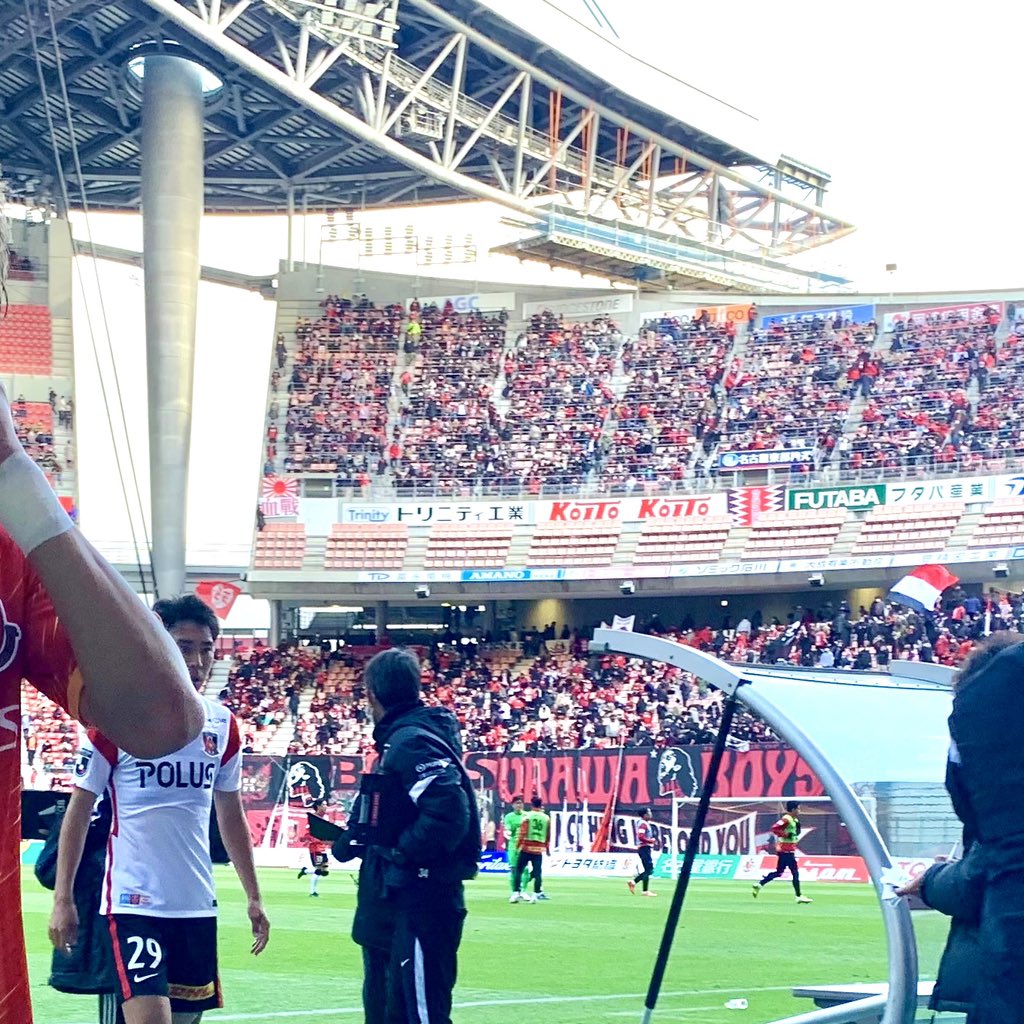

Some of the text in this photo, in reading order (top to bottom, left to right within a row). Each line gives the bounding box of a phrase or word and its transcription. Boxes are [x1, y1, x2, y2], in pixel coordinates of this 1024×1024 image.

[794, 489, 880, 509] FUTABA
[892, 484, 984, 502] フタバ産業
[349, 510, 389, 523] Trinity
[397, 506, 524, 521] トリニティ工業
[469, 570, 525, 580] AMANO
[135, 761, 215, 789] POLUS
[715, 816, 751, 855] YOU
[126, 935, 163, 970] 29
